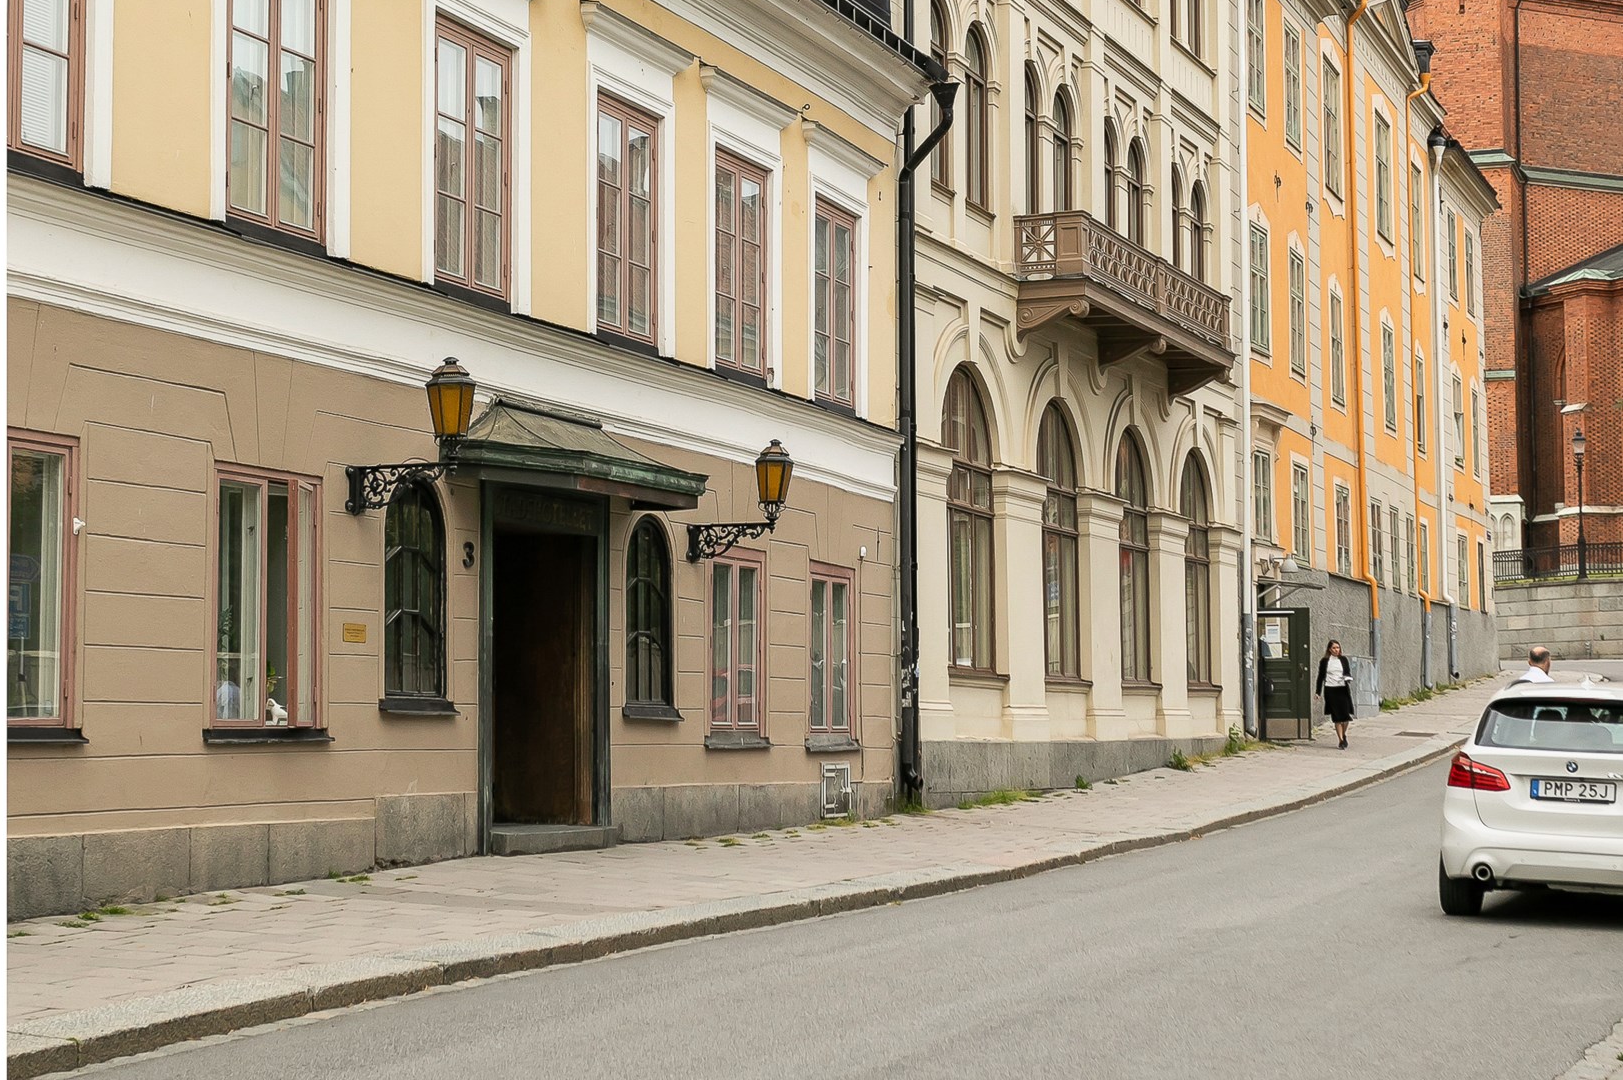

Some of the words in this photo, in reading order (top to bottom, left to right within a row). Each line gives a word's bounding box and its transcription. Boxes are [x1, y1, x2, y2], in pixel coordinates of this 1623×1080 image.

[462, 541, 475, 569] 3
[1544, 781, 1574, 797] PMP
[1578, 783, 1608, 799] 25J
